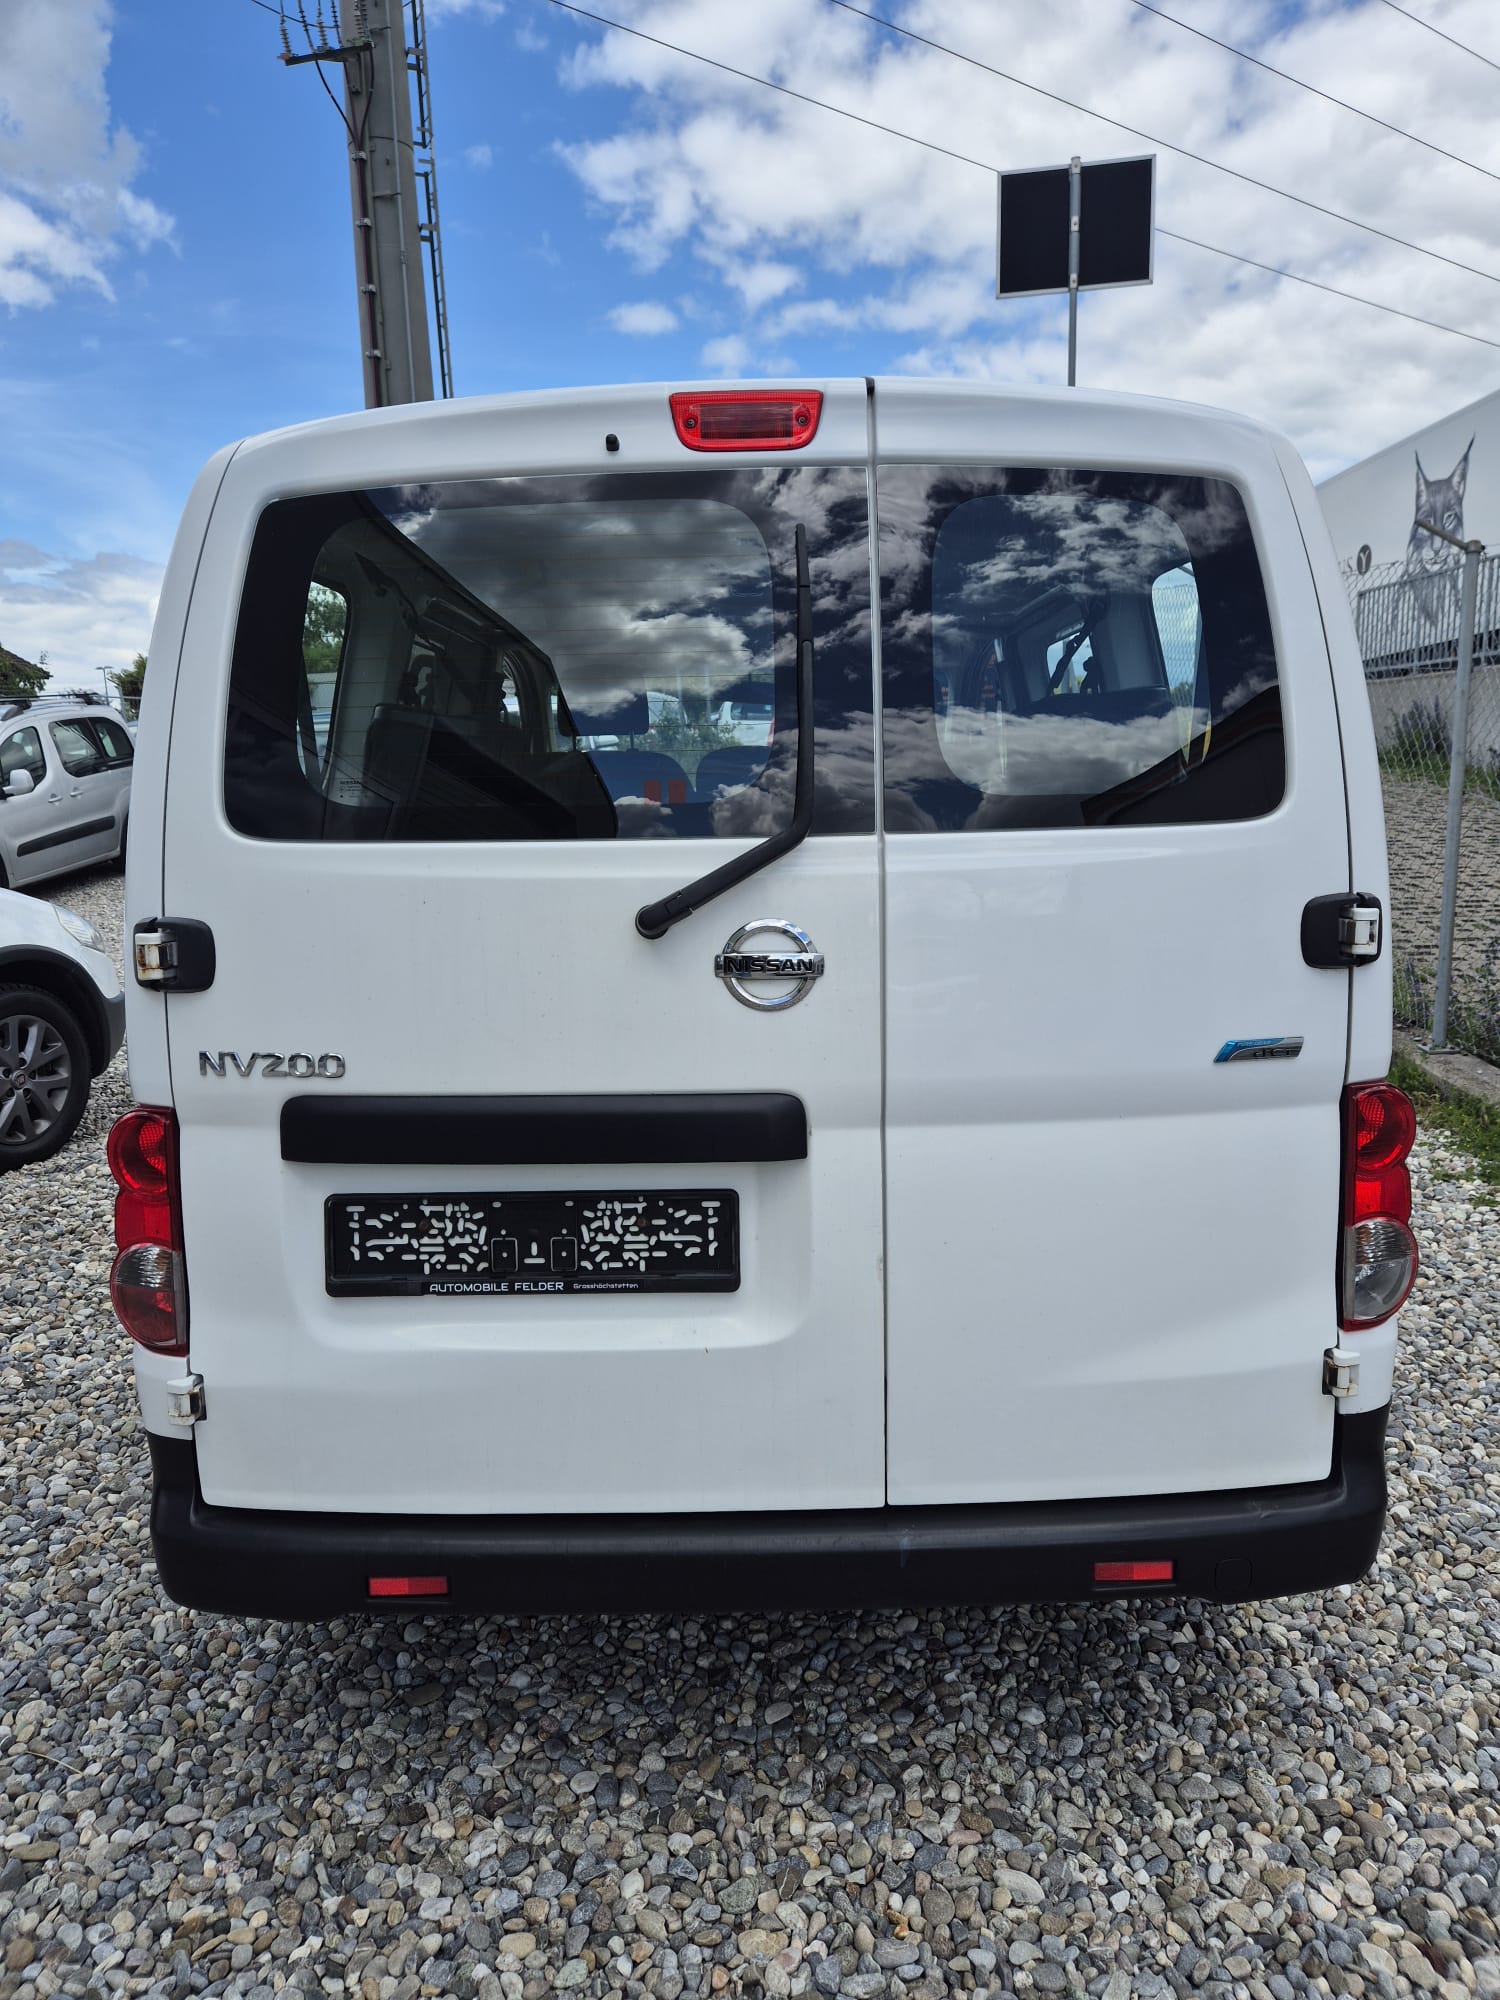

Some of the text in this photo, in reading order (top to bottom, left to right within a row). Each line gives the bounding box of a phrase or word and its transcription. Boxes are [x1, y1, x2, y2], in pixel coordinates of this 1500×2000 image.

[727, 958, 813, 972] NISSAN
[199, 1051, 346, 1078] NV200
[429, 1282, 509, 1292] AUTOMOBILE
[514, 1282, 564, 1291] FELDER
